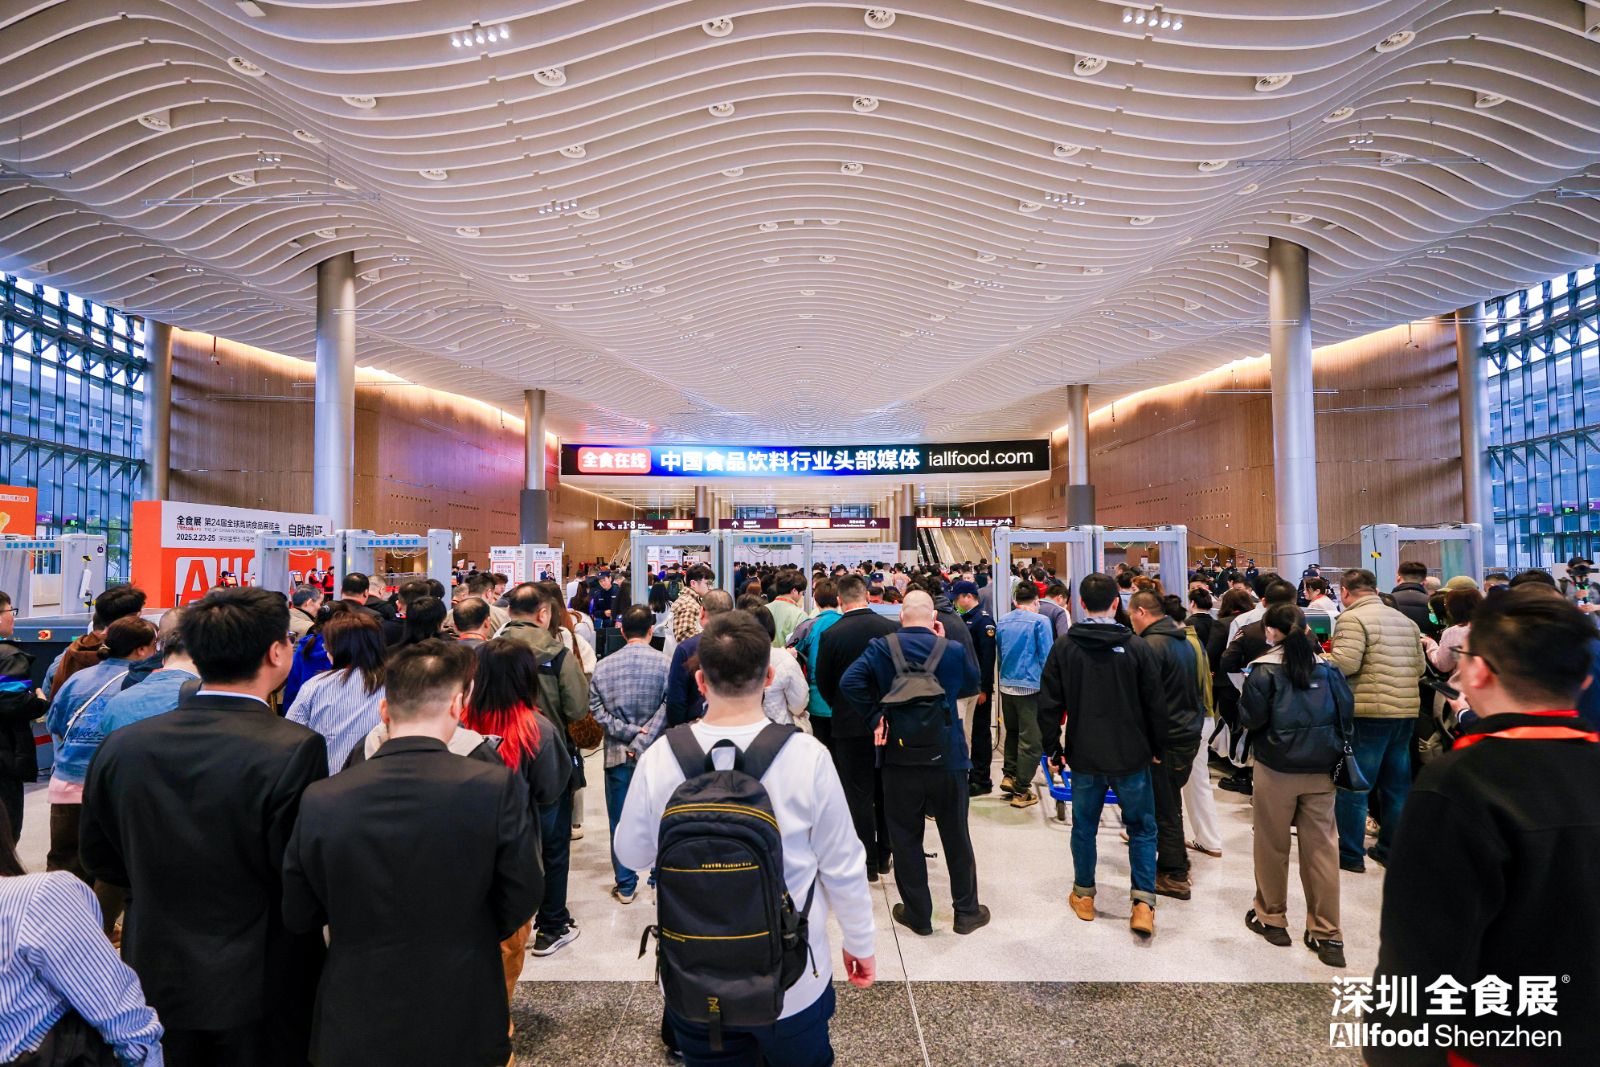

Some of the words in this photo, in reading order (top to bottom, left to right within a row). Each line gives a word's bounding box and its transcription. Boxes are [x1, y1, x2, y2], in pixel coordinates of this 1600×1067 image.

[582, 452, 647, 468] 全食在线
[660, 449, 920, 472] 中国食品饮料行业头部媒体
[928, 450, 1034, 467] iallfood.com
[176, 515, 202, 526] 全食展
[176, 533, 216, 542] 2025.2.23-25
